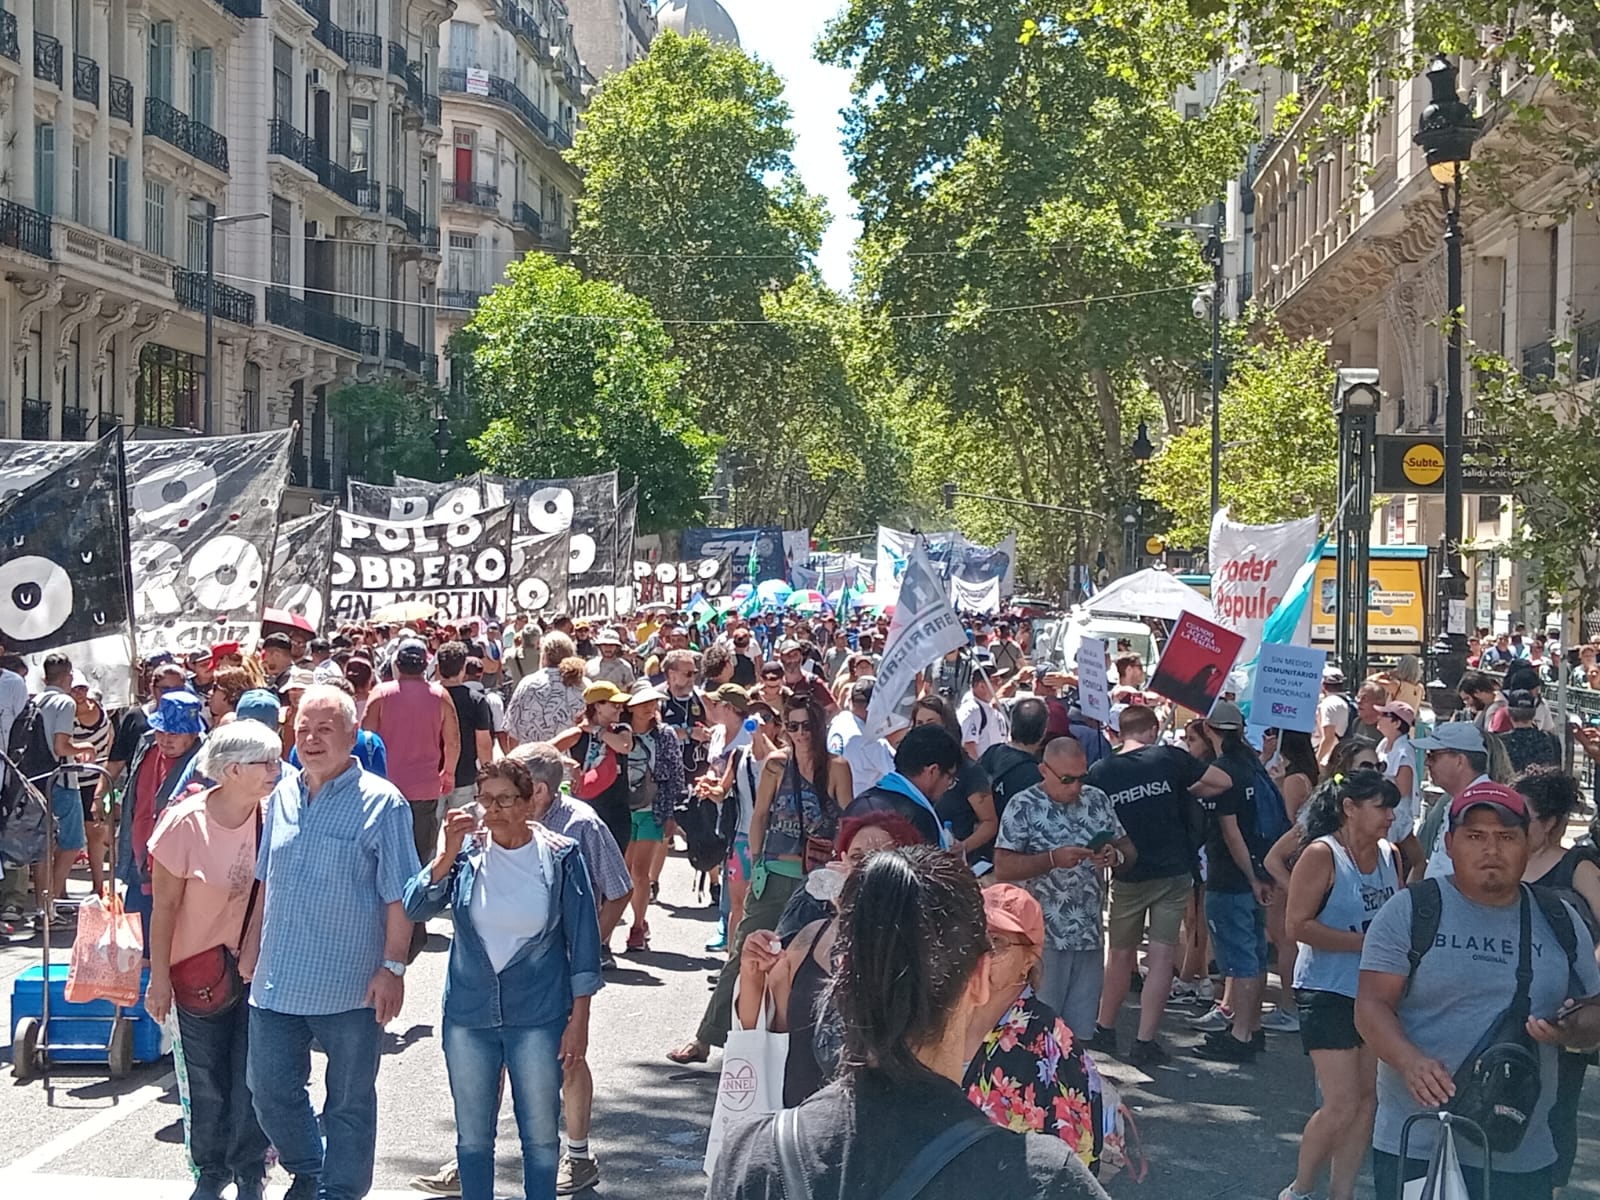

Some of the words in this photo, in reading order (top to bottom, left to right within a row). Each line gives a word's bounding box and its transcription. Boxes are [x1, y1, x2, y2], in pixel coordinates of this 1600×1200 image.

[1408, 457, 1439, 468] Subte
[341, 513, 484, 553] POLO
[633, 559, 720, 584] POLO
[1271, 655, 1284, 664] SIN
[1284, 658, 1313, 669] MEDIOS
[1262, 665, 1318, 680] COMUNITARIOS
[1274, 677, 1287, 687] NO
[1287, 680, 1304, 688] HAY
[1262, 686, 1312, 699] DEMOCRACIA
[1110, 780, 1173, 808] PRENSA
